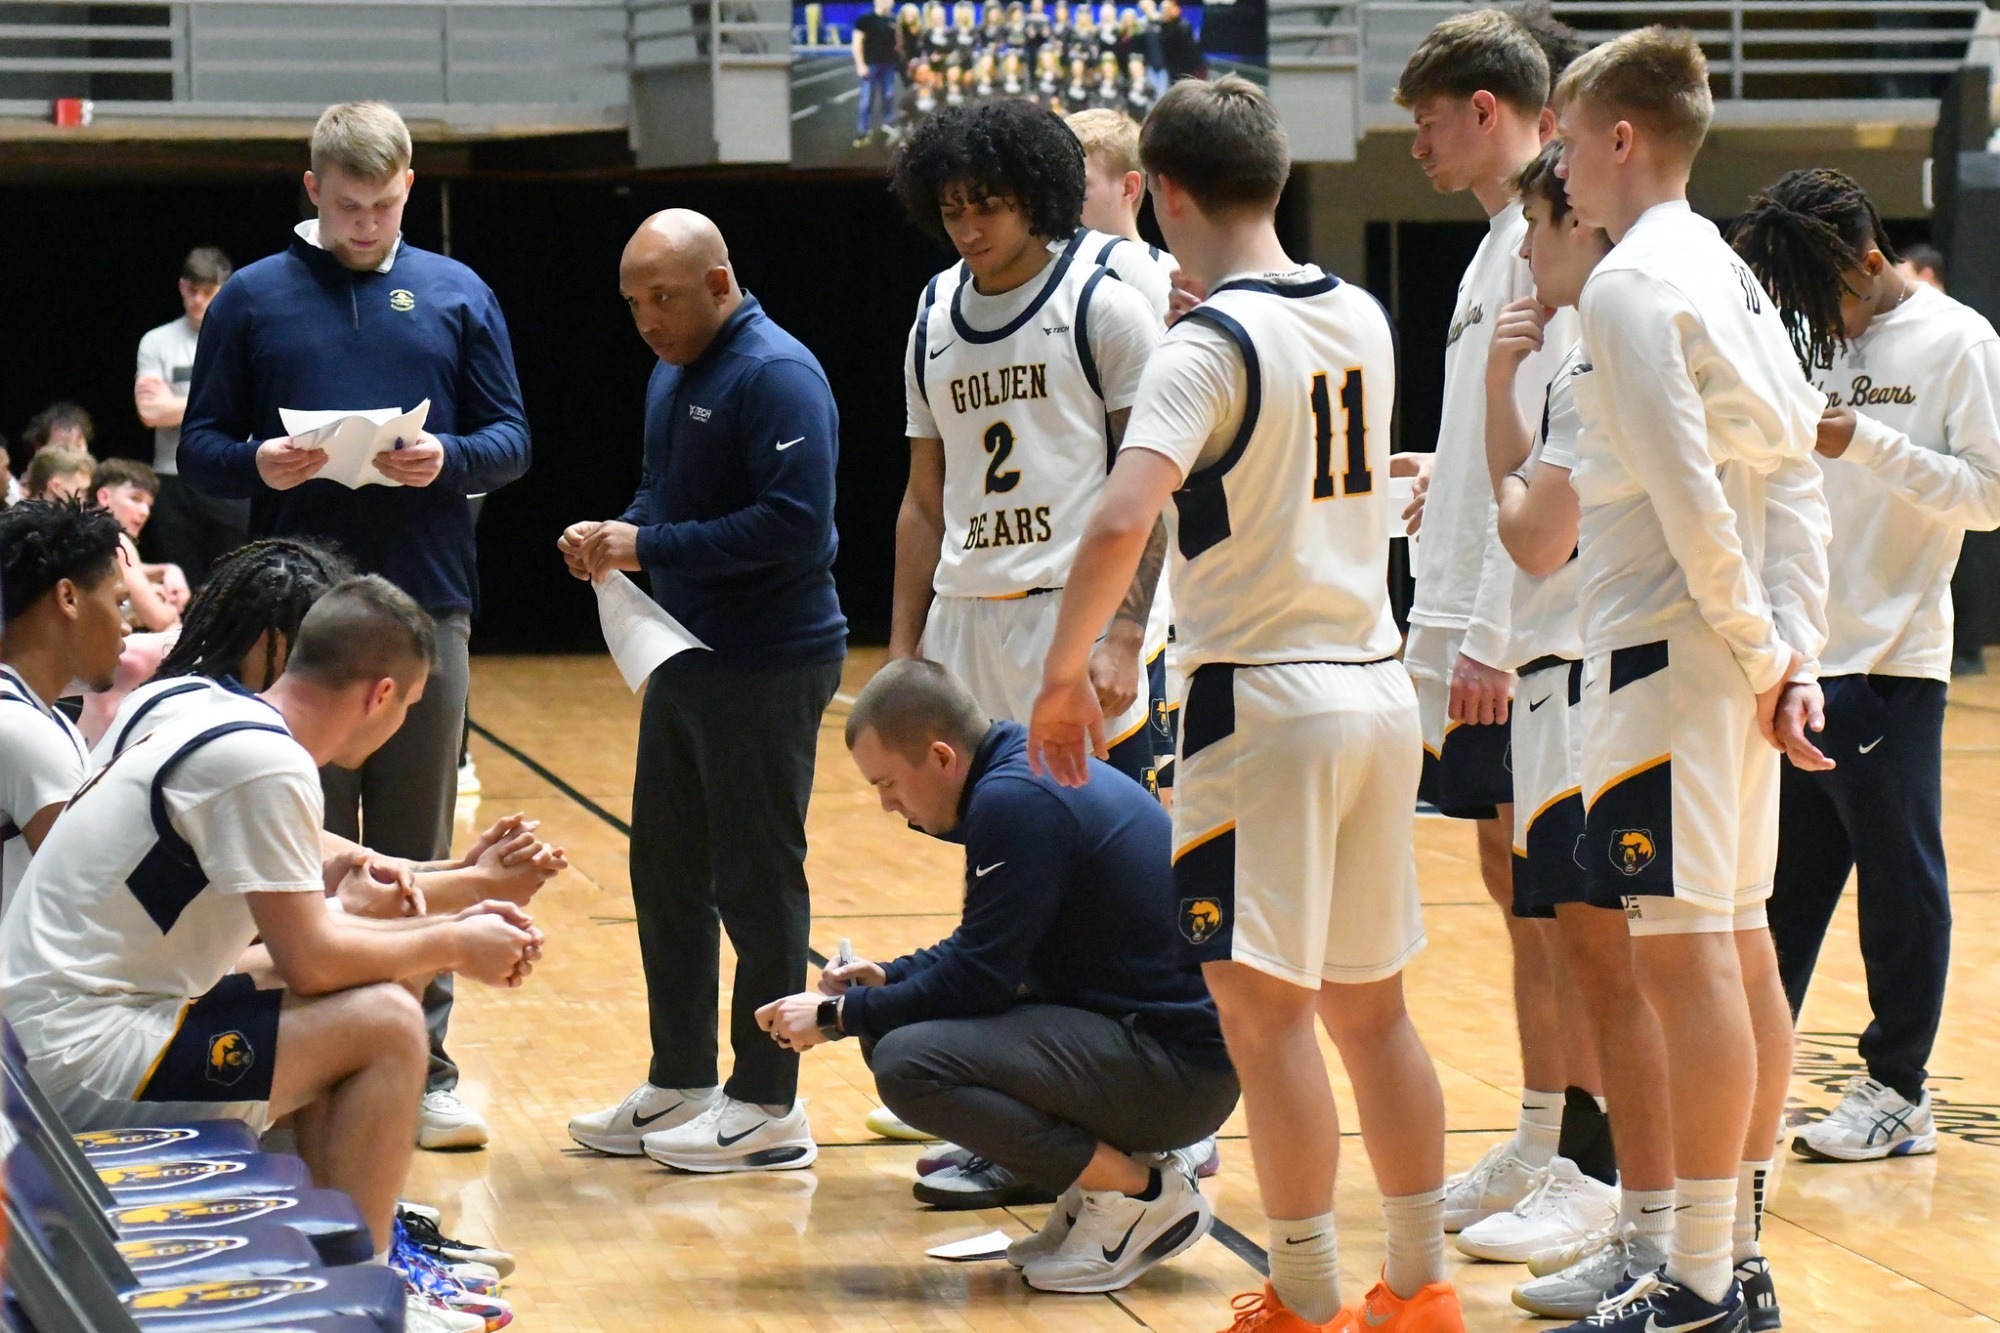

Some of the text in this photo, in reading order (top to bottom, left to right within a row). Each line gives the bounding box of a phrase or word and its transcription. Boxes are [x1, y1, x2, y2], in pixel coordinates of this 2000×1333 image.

[1730, 262, 1761, 315] 30
[950, 363, 1048, 414] GOLDEN
[1847, 375, 1916, 406] Bears
[981, 419, 1023, 496] 2
[1310, 366, 1373, 503] 11
[963, 506, 1052, 551] BEARS
